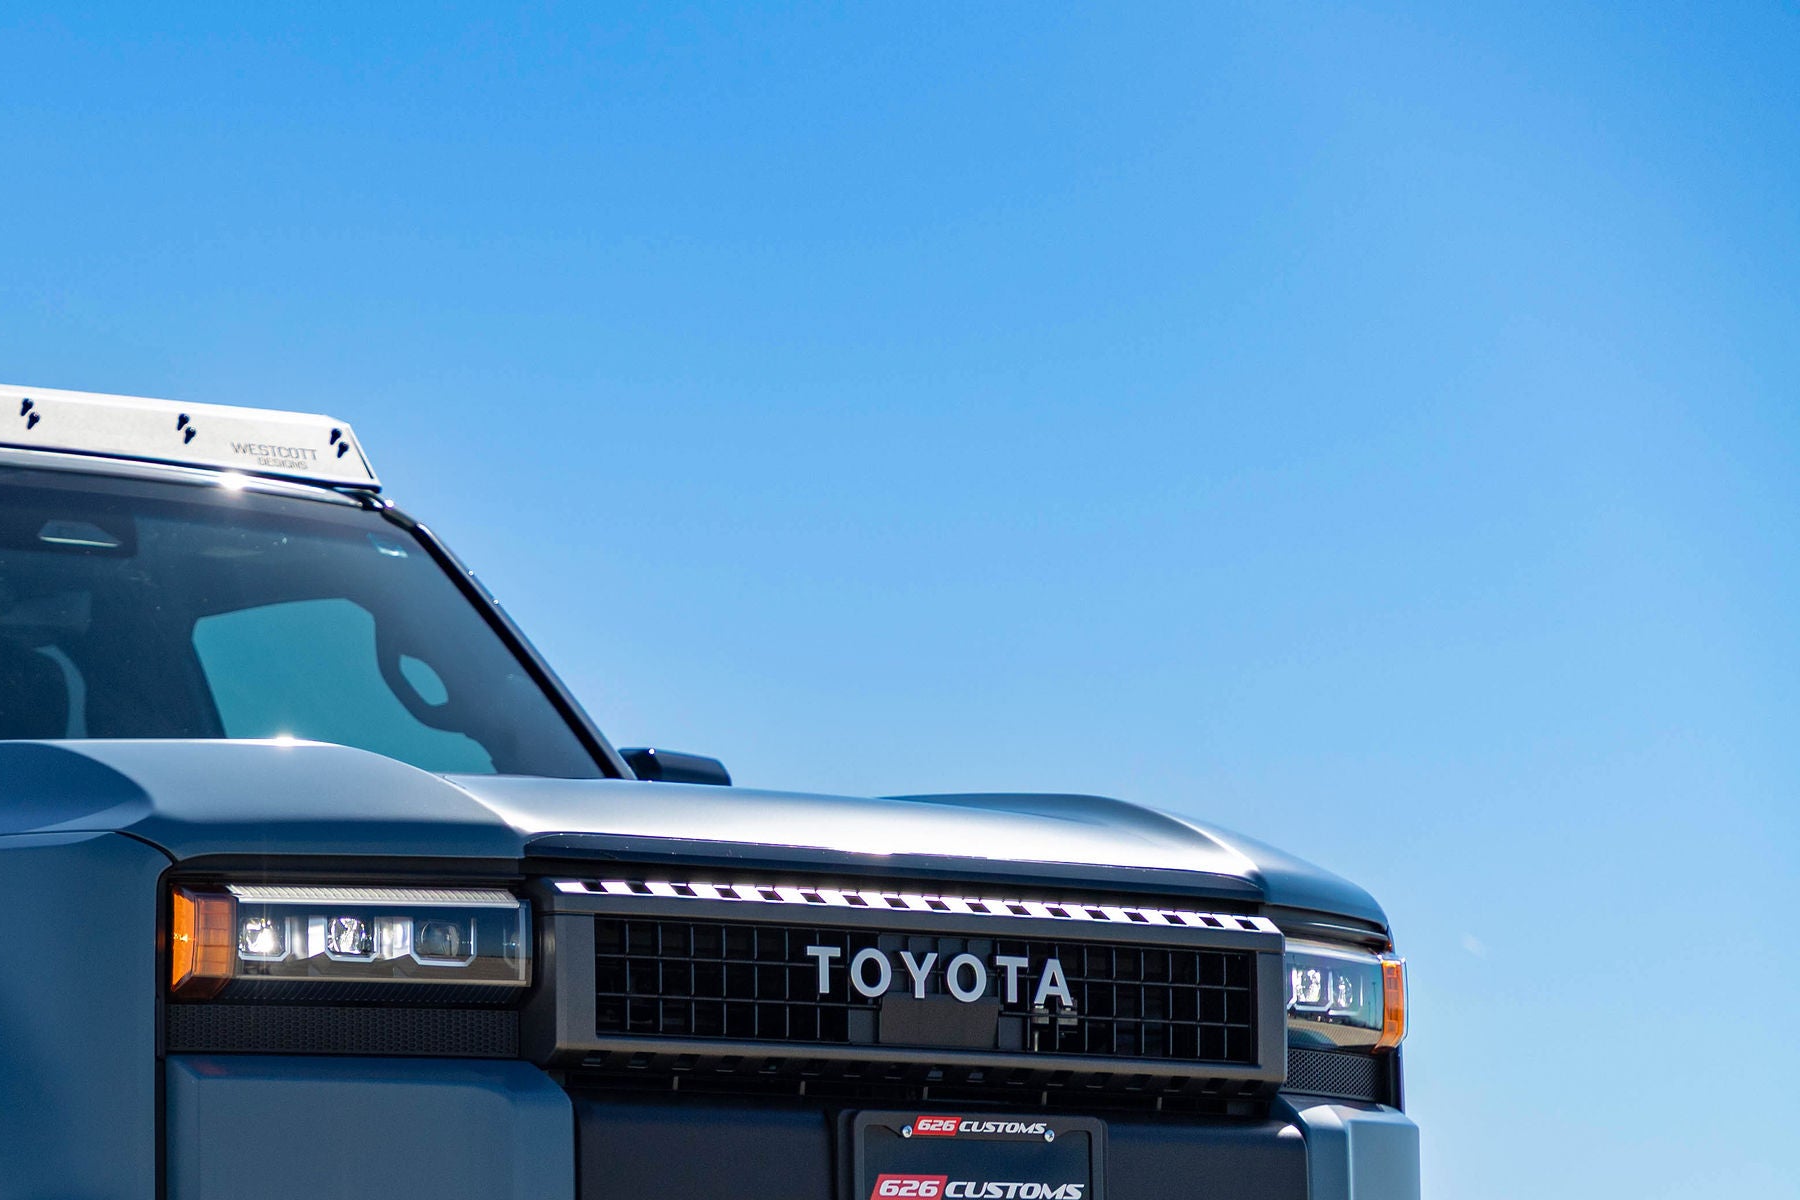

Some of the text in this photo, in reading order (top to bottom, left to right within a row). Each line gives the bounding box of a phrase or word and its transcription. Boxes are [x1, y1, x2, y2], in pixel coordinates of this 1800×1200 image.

[231, 442, 318, 461] WESTCOTT
[257, 457, 308, 470] DESIGNS
[806, 945, 1073, 1007] TOYOTA
[917, 1119, 1047, 1135] 626 CUSTOMS
[879, 1179, 1084, 1200] 626 CUSTOMS
